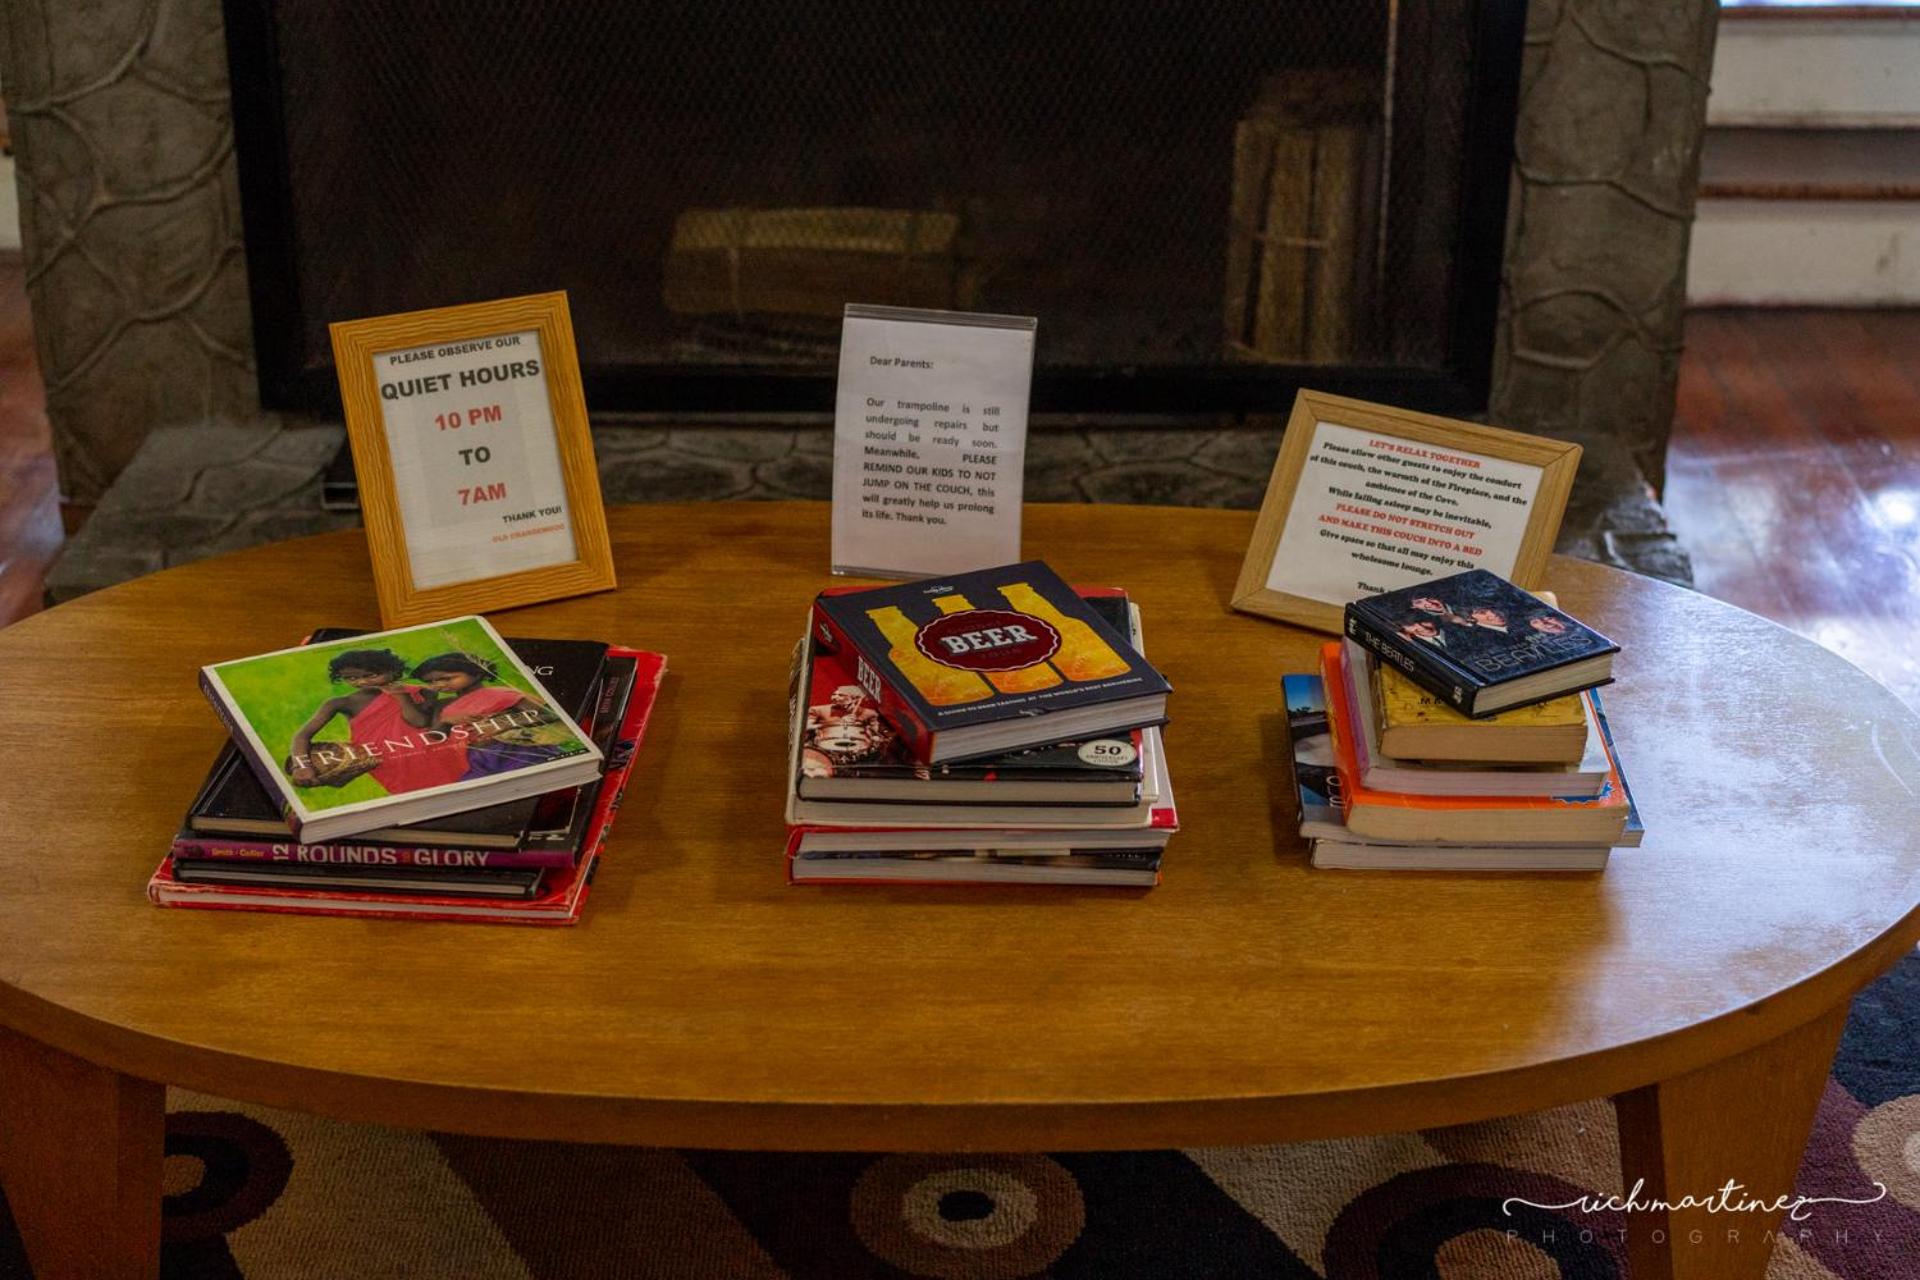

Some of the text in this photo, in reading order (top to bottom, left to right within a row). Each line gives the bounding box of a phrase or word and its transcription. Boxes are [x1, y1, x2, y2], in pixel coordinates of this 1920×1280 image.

[390, 336, 521, 366] PLEASE OBSERVE OUR
[870, 356, 934, 370] Dear Parents:
[381, 360, 540, 401] QUIET HOURS
[435, 405, 502, 431] 10 PM
[866, 397, 1001, 416] Our trampoline is still
[865, 414, 999, 433] undergoing repairs but
[865, 430, 998, 449] should be ready soon.
[459, 447, 491, 466] TO
[962, 453, 997, 466] PLEASE
[1323, 441, 1522, 490] Please allow other guests to enjoy the comfort
[1369, 440, 1481, 469] LET'S RELAX TOGETHER
[863, 462, 996, 481] REMIND OUR KIDS TO NOT
[1310, 454, 1528, 506] of this couch, the warmth of the Fireplace, and the
[458, 483, 507, 506] 7AM
[862, 478, 995, 498] JUMP ON THE COUCH, this
[1408, 488, 1418, 497] of
[1418, 491, 1433, 500] the
[502, 505, 562, 523] THANK YOU!
[862, 493, 995, 515] will greatly help us prolong
[1328, 485, 1492, 530] While falling asleep may be inevitable,
[862, 509, 947, 526] its life. Thank you.
[1336, 502, 1475, 539] PLEASE DO NOT STRETCH OUT
[1318, 514, 1483, 557] AND MAKE THIS COUCH INTO A BED
[1320, 528, 1475, 570] Give space so that all may enjoy this
[1351, 551, 1433, 576] wholesome lounge.
[1357, 581, 1385, 594] Thank
[940, 624, 1040, 655] BEER
[1364, 630, 1416, 673] THE BEATLES
[857, 654, 882, 704] BEER
[294, 708, 541, 770] FRIENDSHIP
[1094, 744, 1122, 756] 50
[272, 843, 290, 861] 12
[296, 844, 398, 866] ROUNDS
[414, 847, 491, 868] GLORY
